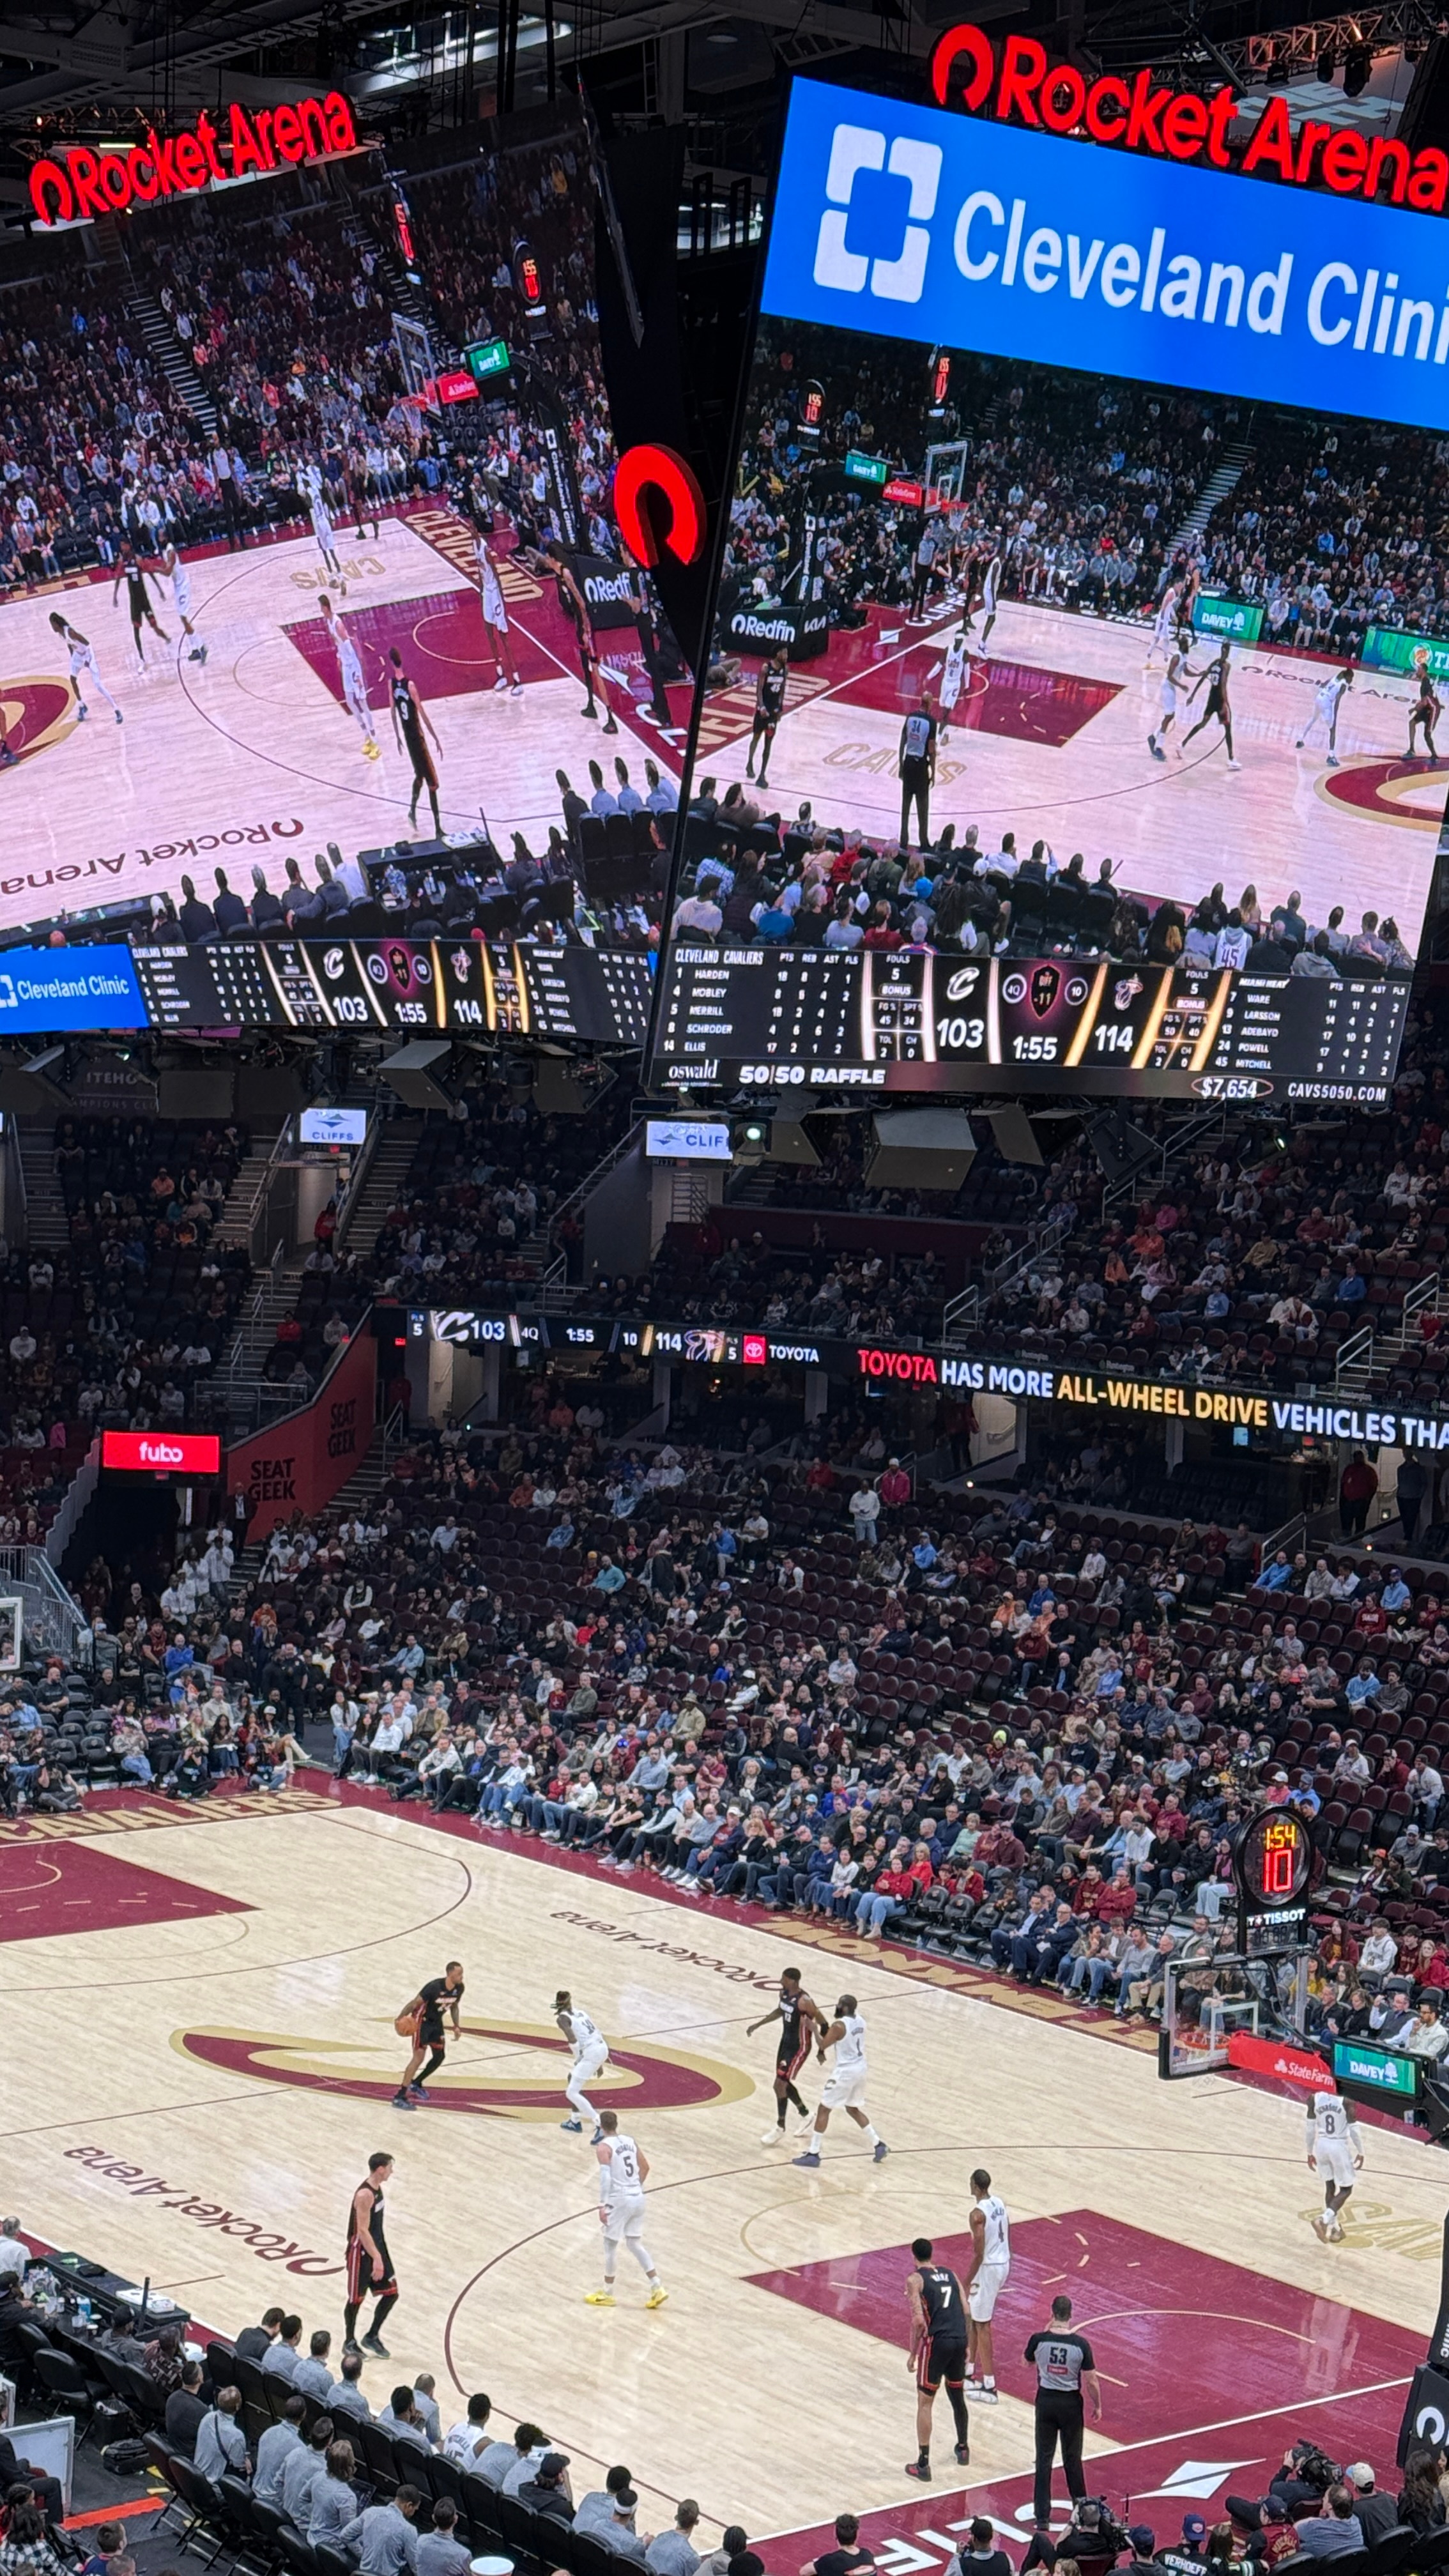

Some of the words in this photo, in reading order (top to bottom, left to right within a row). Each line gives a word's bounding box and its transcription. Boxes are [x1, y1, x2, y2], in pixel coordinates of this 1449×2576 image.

[997, 34, 1239, 167] Rocket
[1242, 96, 1448, 212] Arena
[66, 110, 227, 217] Rocket
[229, 90, 358, 177] Arena
[954, 191, 1294, 335] Cleveland
[597, 572, 631, 601] Redfi
[746, 615, 796, 643] Redfin
[1202, 613, 1234, 629] DAVEY
[136, 824, 271, 866] Rocket
[1, 852, 126, 894] Arena
[675, 948, 719, 963] CLEVELAND
[723, 950, 764, 965] CAVALIERS
[779, 952, 795, 962] PTS
[824, 954, 839, 964] AST
[886, 954, 910, 964] FOULS
[677, 967, 682, 979] 1
[694, 969, 730, 980] HARDEN
[824, 972, 830, 983] 7
[845, 973, 851, 984] 1
[891, 968, 900, 981] 5
[17, 977, 89, 1000] Cleveland
[88, 975, 130, 996] Clinic
[673, 985, 681, 997] 4
[692, 988, 726, 998] MOBLEY
[820, 990, 827, 1000] 4
[842, 990, 850, 1002] 2
[1071, 986, 1082, 997] 10
[1190, 983, 1199, 995] 5
[333, 997, 368, 1022] 103
[394, 1002, 427, 1023] 1:55
[454, 999, 482, 1023] 114
[670, 1003, 678, 1016] 5
[689, 1006, 724, 1016] MERRILL
[795, 1007, 803, 1018] 2
[817, 1008, 825, 1018] 4
[840, 1009, 845, 1019] 1
[1230, 991, 1237, 1002] 7
[1247, 994, 1271, 1004] WARE
[1370, 1002, 1377, 1011] 4
[1392, 1003, 1399, 1013] 2
[1226, 1008, 1234, 1018] 9
[1244, 1010, 1280, 1021] LARSSON
[1367, 1018, 1374, 1027] 2
[1390, 1019, 1395, 1029] 1
[769, 1024, 776, 1035] 4
[815, 1025, 822, 1036] 6
[837, 1026, 844, 1037] 2
[937, 1018, 985, 1048] 103
[1094, 1024, 1133, 1052] 114
[1241, 1027, 1279, 1037] ADEBAYO
[1346, 1032, 1356, 1042] 10
[1387, 1035, 1392, 1045] 1
[684, 1042, 706, 1052] ELLIS
[767, 1042, 777, 1053] 17
[790, 1042, 797, 1053] 2
[813, 1043, 818, 1054] 1
[834, 1044, 841, 1054] 2
[880, 1047, 887, 1057] 2
[1013, 1036, 1058, 1061] 1:55
[1218, 1039, 1230, 1051] 24
[1238, 1043, 1269, 1054] POWELL
[1343, 1048, 1349, 1058] 4
[1361, 1049, 1368, 1059] 2
[1383, 1050, 1390, 1060] 2
[668, 1059, 717, 1078] oswald
[1155, 1057, 1162, 1066] 2
[1215, 1056, 1228, 1067] 45
[1236, 1059, 1272, 1070] MITCHELL
[1341, 1064, 1346, 1073] 1
[1358, 1065, 1365, 1075] 2
[1381, 1066, 1387, 1076] 2
[810, 1068, 886, 1084] RAFFLE
[1201, 1077, 1257, 1100] $7,654
[1288, 1082, 1386, 1101] CAVS5050.COM
[312, 1131, 354, 1142] CLIFFS
[413, 1323, 422, 1337] 5
[470, 1321, 505, 1340] 103
[521, 1327, 539, 1340] 4Q
[566, 1328, 595, 1342] 1:55
[623, 1332, 637, 1346] 10
[656, 1332, 682, 1351] 114
[728, 1347, 737, 1360] 5
[769, 1344, 820, 1363] TOYOTA
[857, 1349, 937, 1384] TOYOTA
[941, 1360, 984, 1388] HAS
[988, 1365, 1054, 1398] MORE
[1057, 1374, 1190, 1417] ALL-WHEEL
[1195, 1391, 1268, 1427] DRIVE
[1273, 1401, 1396, 1444] VEHICLES
[330, 1399, 356, 1430] SEAT
[139, 1441, 183, 1464] fubo
[328, 1428, 356, 1459] GEEK
[250, 1458, 295, 1481] SEAT
[248, 1480, 296, 1501] GEEK
[0, 1791, 342, 1841] CAVALIERS
[1266, 1825, 1296, 1850] 1:54
[1263, 1849, 1292, 1892] 10
[549, 1911, 656, 1942] Arena
[1263, 1908, 1306, 1926] TISSOT
[638, 1942, 770, 1982] Rocket
[1349, 2061, 1385, 2081] DAVEY
[1325, 2114, 1335, 2135] 8
[63, 2146, 188, 2196] Arena
[623, 2156, 634, 2177] 5
[157, 2196, 314, 2261] Rocket
[940, 2286, 952, 2308] 7
[1049, 2346, 1068, 2365] 53
